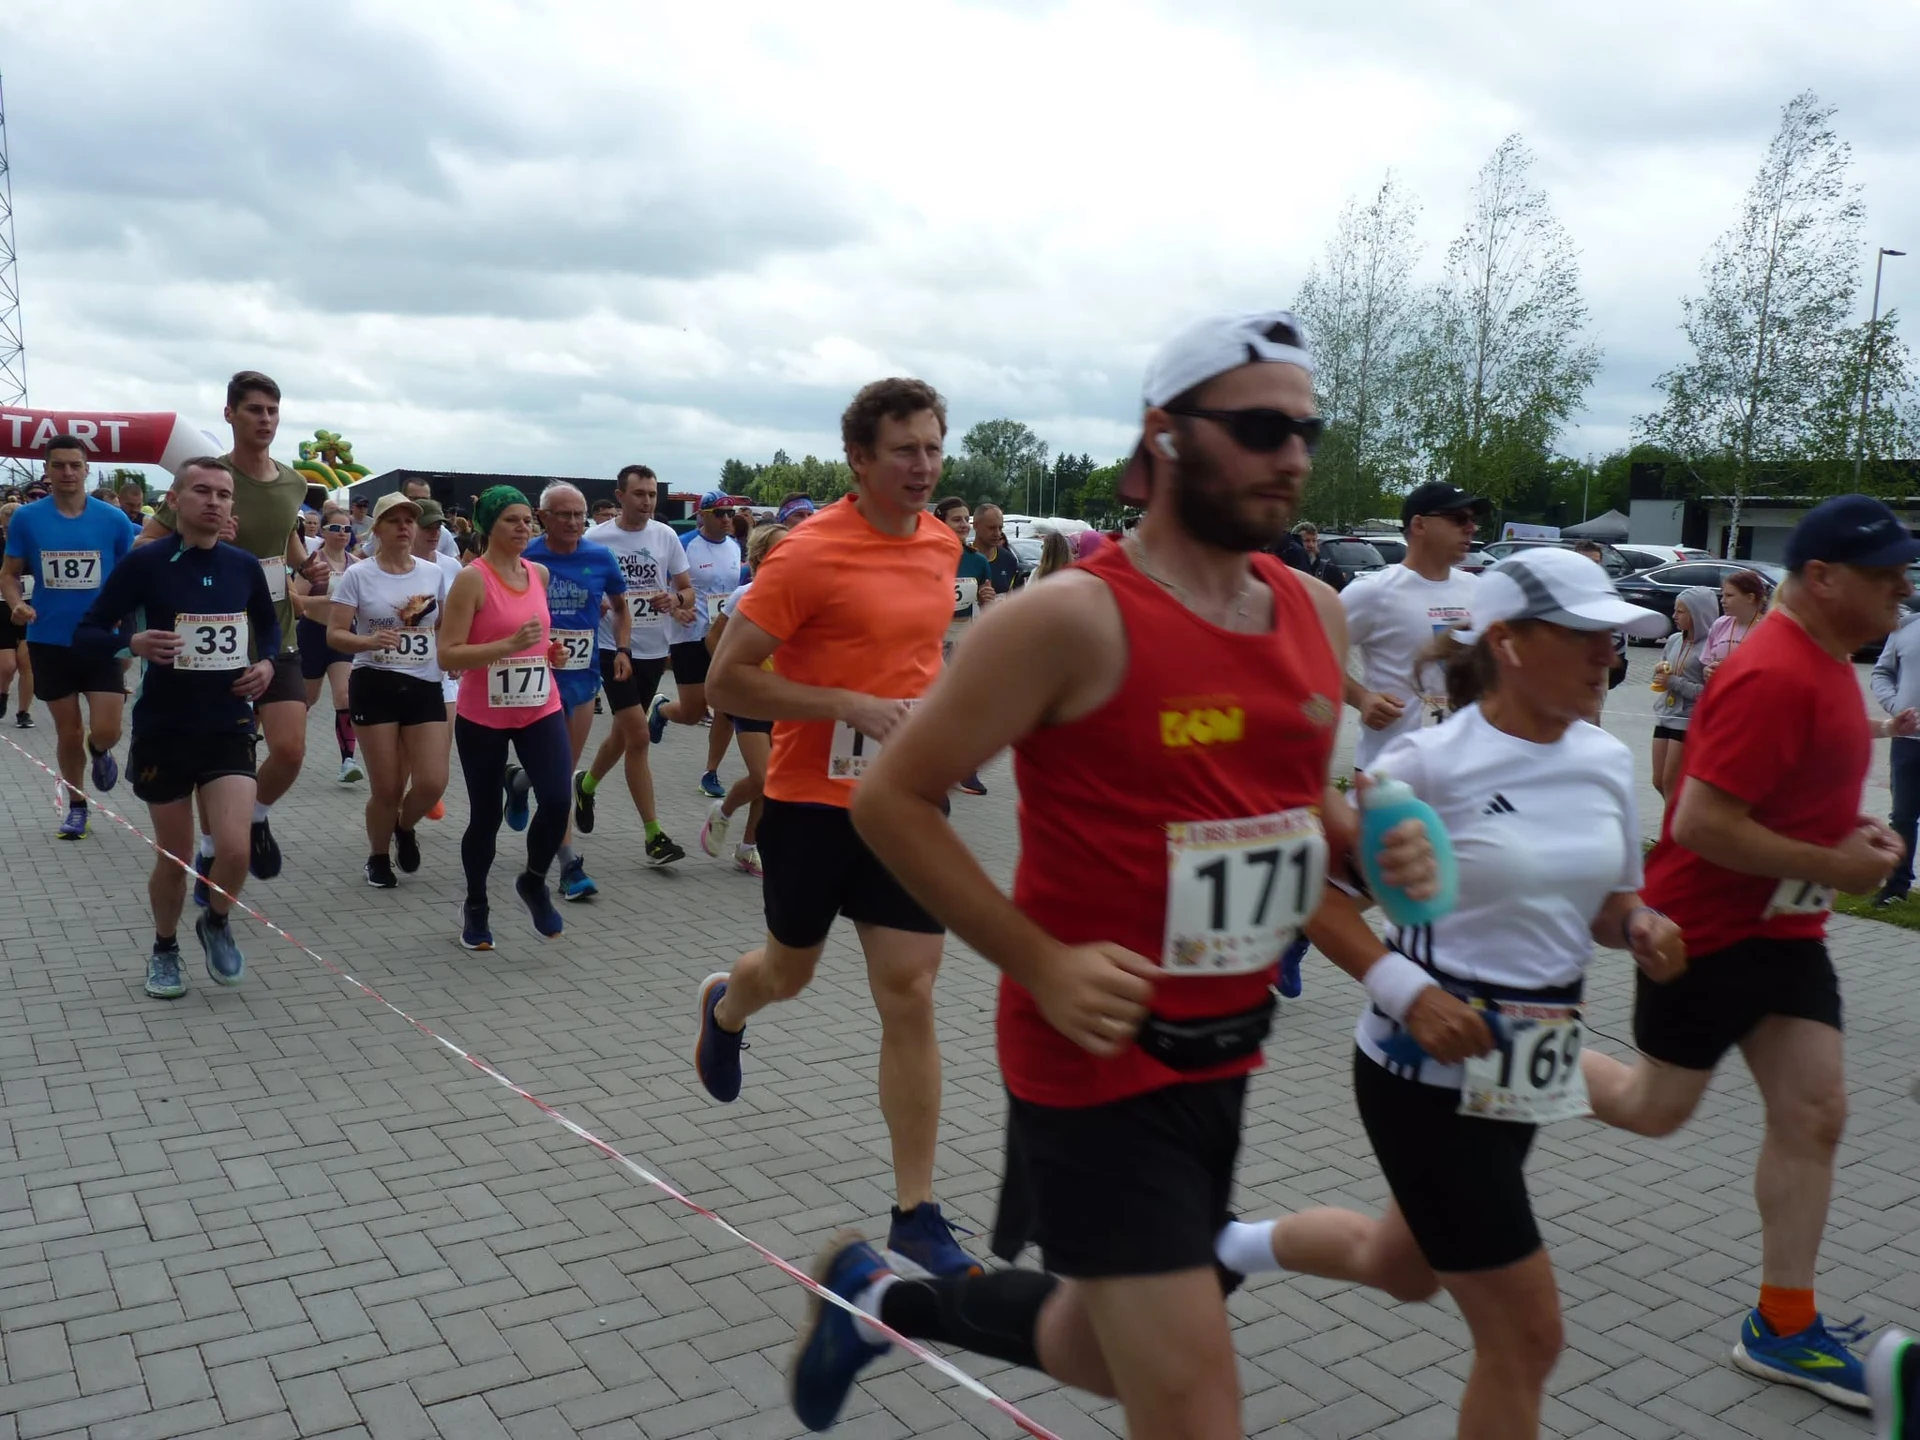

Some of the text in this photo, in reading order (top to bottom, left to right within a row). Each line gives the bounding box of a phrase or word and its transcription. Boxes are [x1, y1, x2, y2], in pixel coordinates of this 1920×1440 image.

[48, 559, 96, 579] 187
[626, 598, 658, 617] 24
[195, 625, 237, 655] 33
[384, 633, 429, 655] 03
[550, 637, 589, 659] 52
[496, 666, 545, 693] 177
[1195, 841, 1309, 931] 171
[1497, 1026, 1581, 1089] 169
